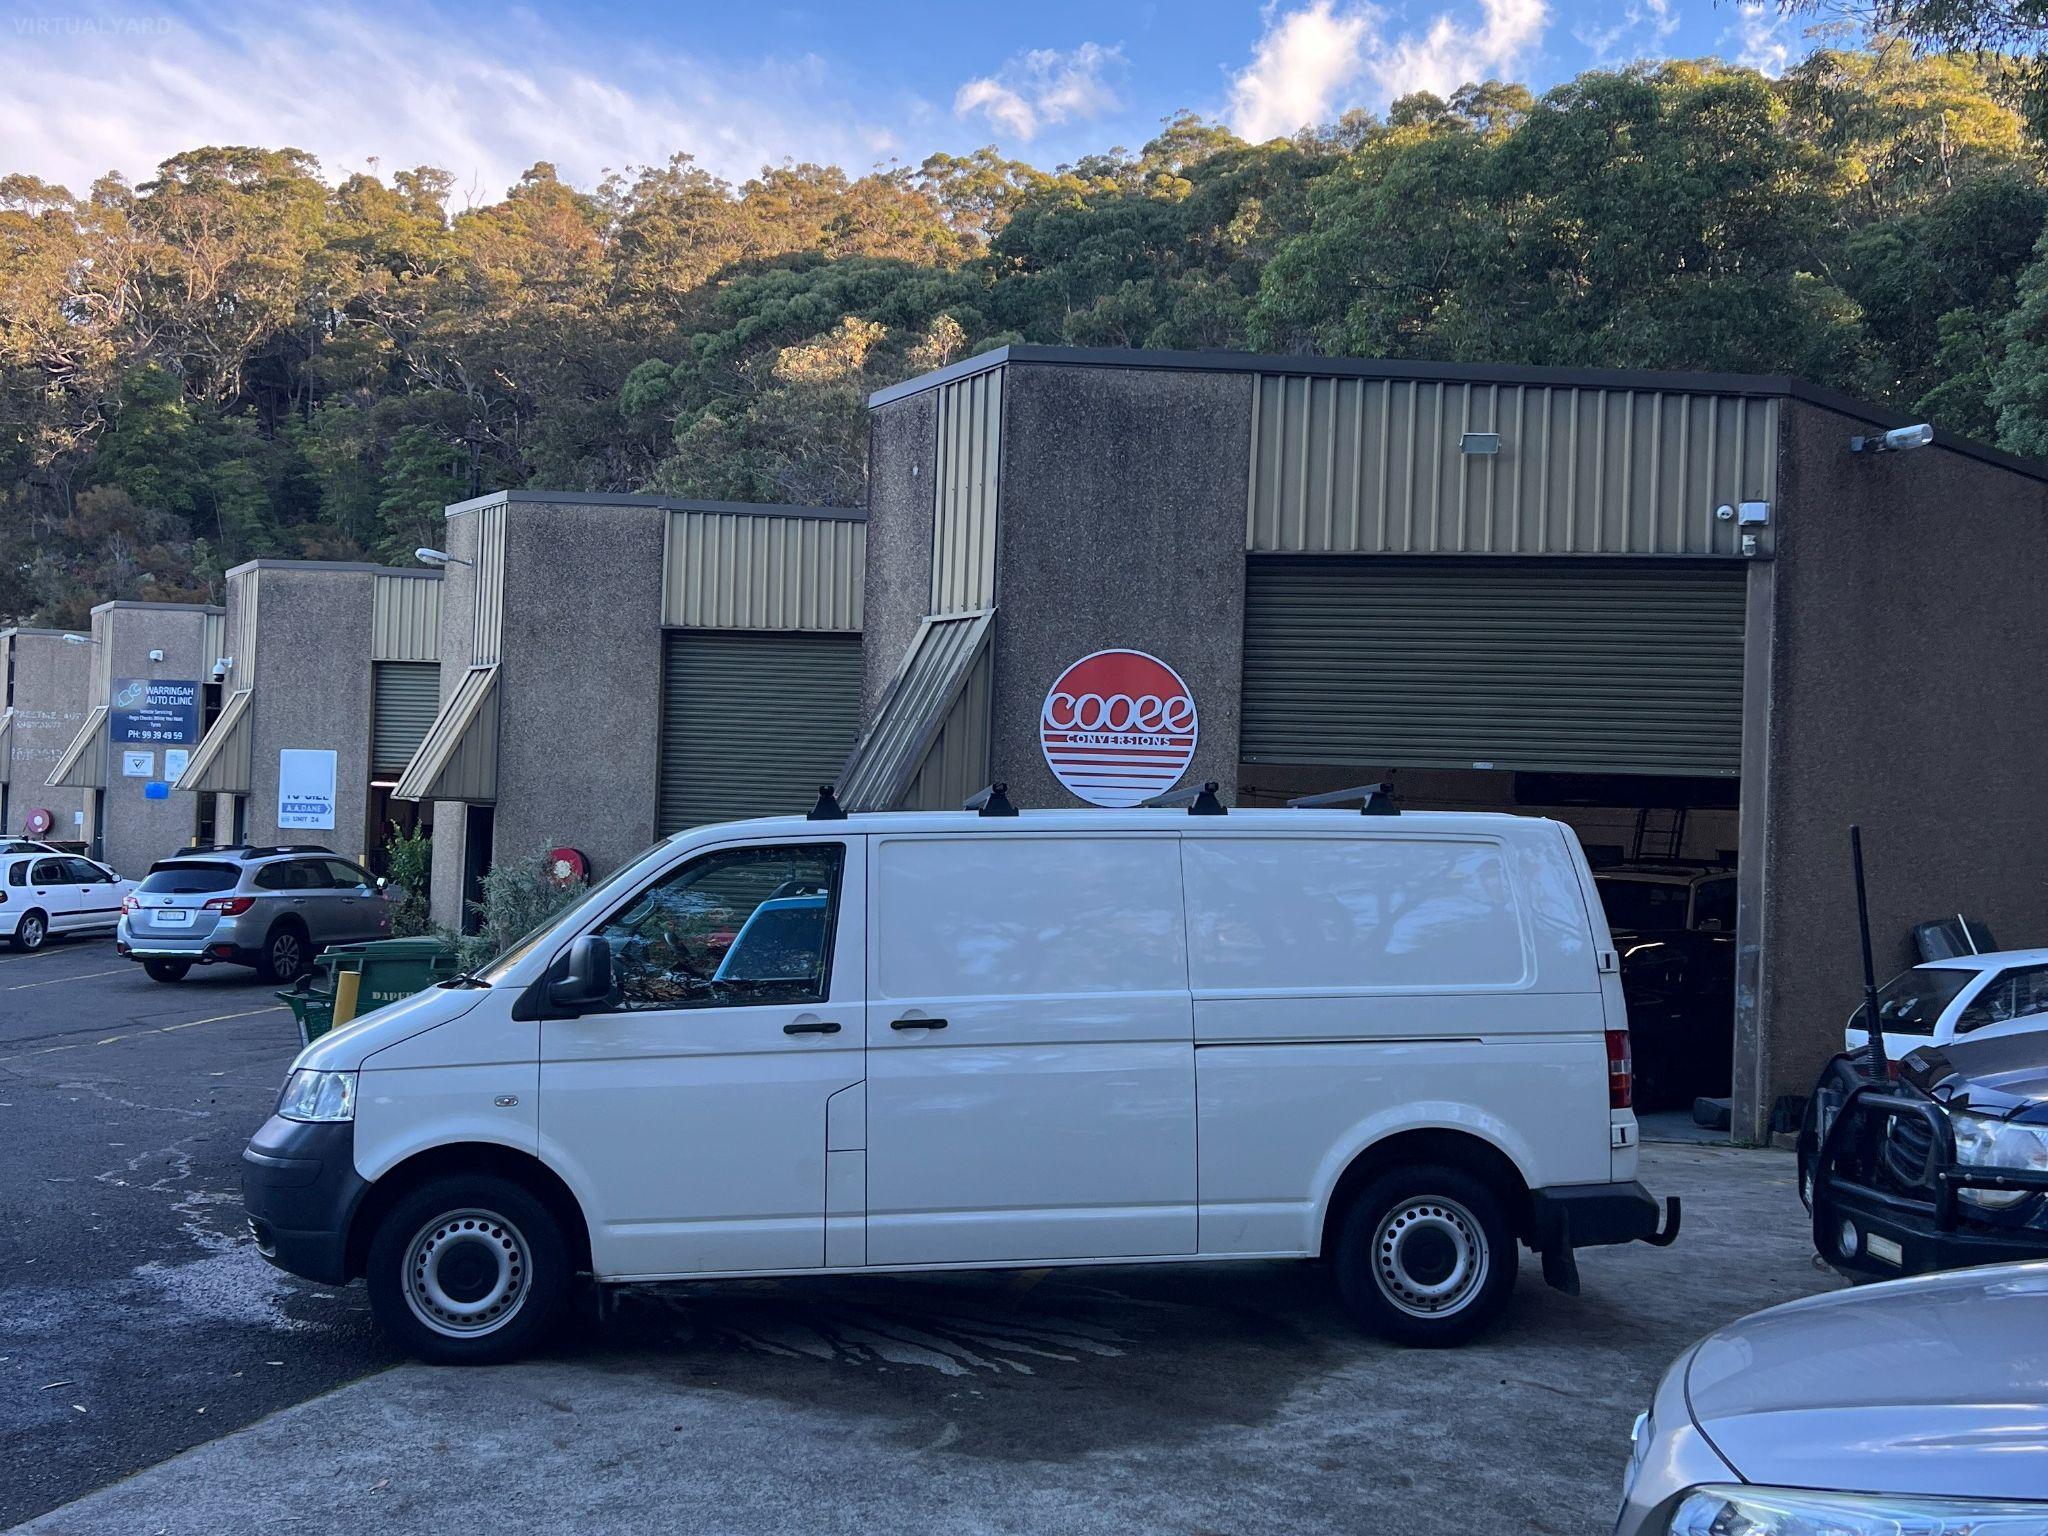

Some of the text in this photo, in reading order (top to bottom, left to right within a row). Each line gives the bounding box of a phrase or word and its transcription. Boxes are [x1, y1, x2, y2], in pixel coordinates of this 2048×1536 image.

[145, 686, 193, 696] WARRINGAH
[146, 696, 193, 706] AUTO CLINIC
[1042, 692, 1196, 734] cooee
[142, 730, 151, 739] 99
[152, 731, 161, 739] 39
[162, 731, 172, 740] 49
[1066, 734, 1172, 746] CONVERSIONS
